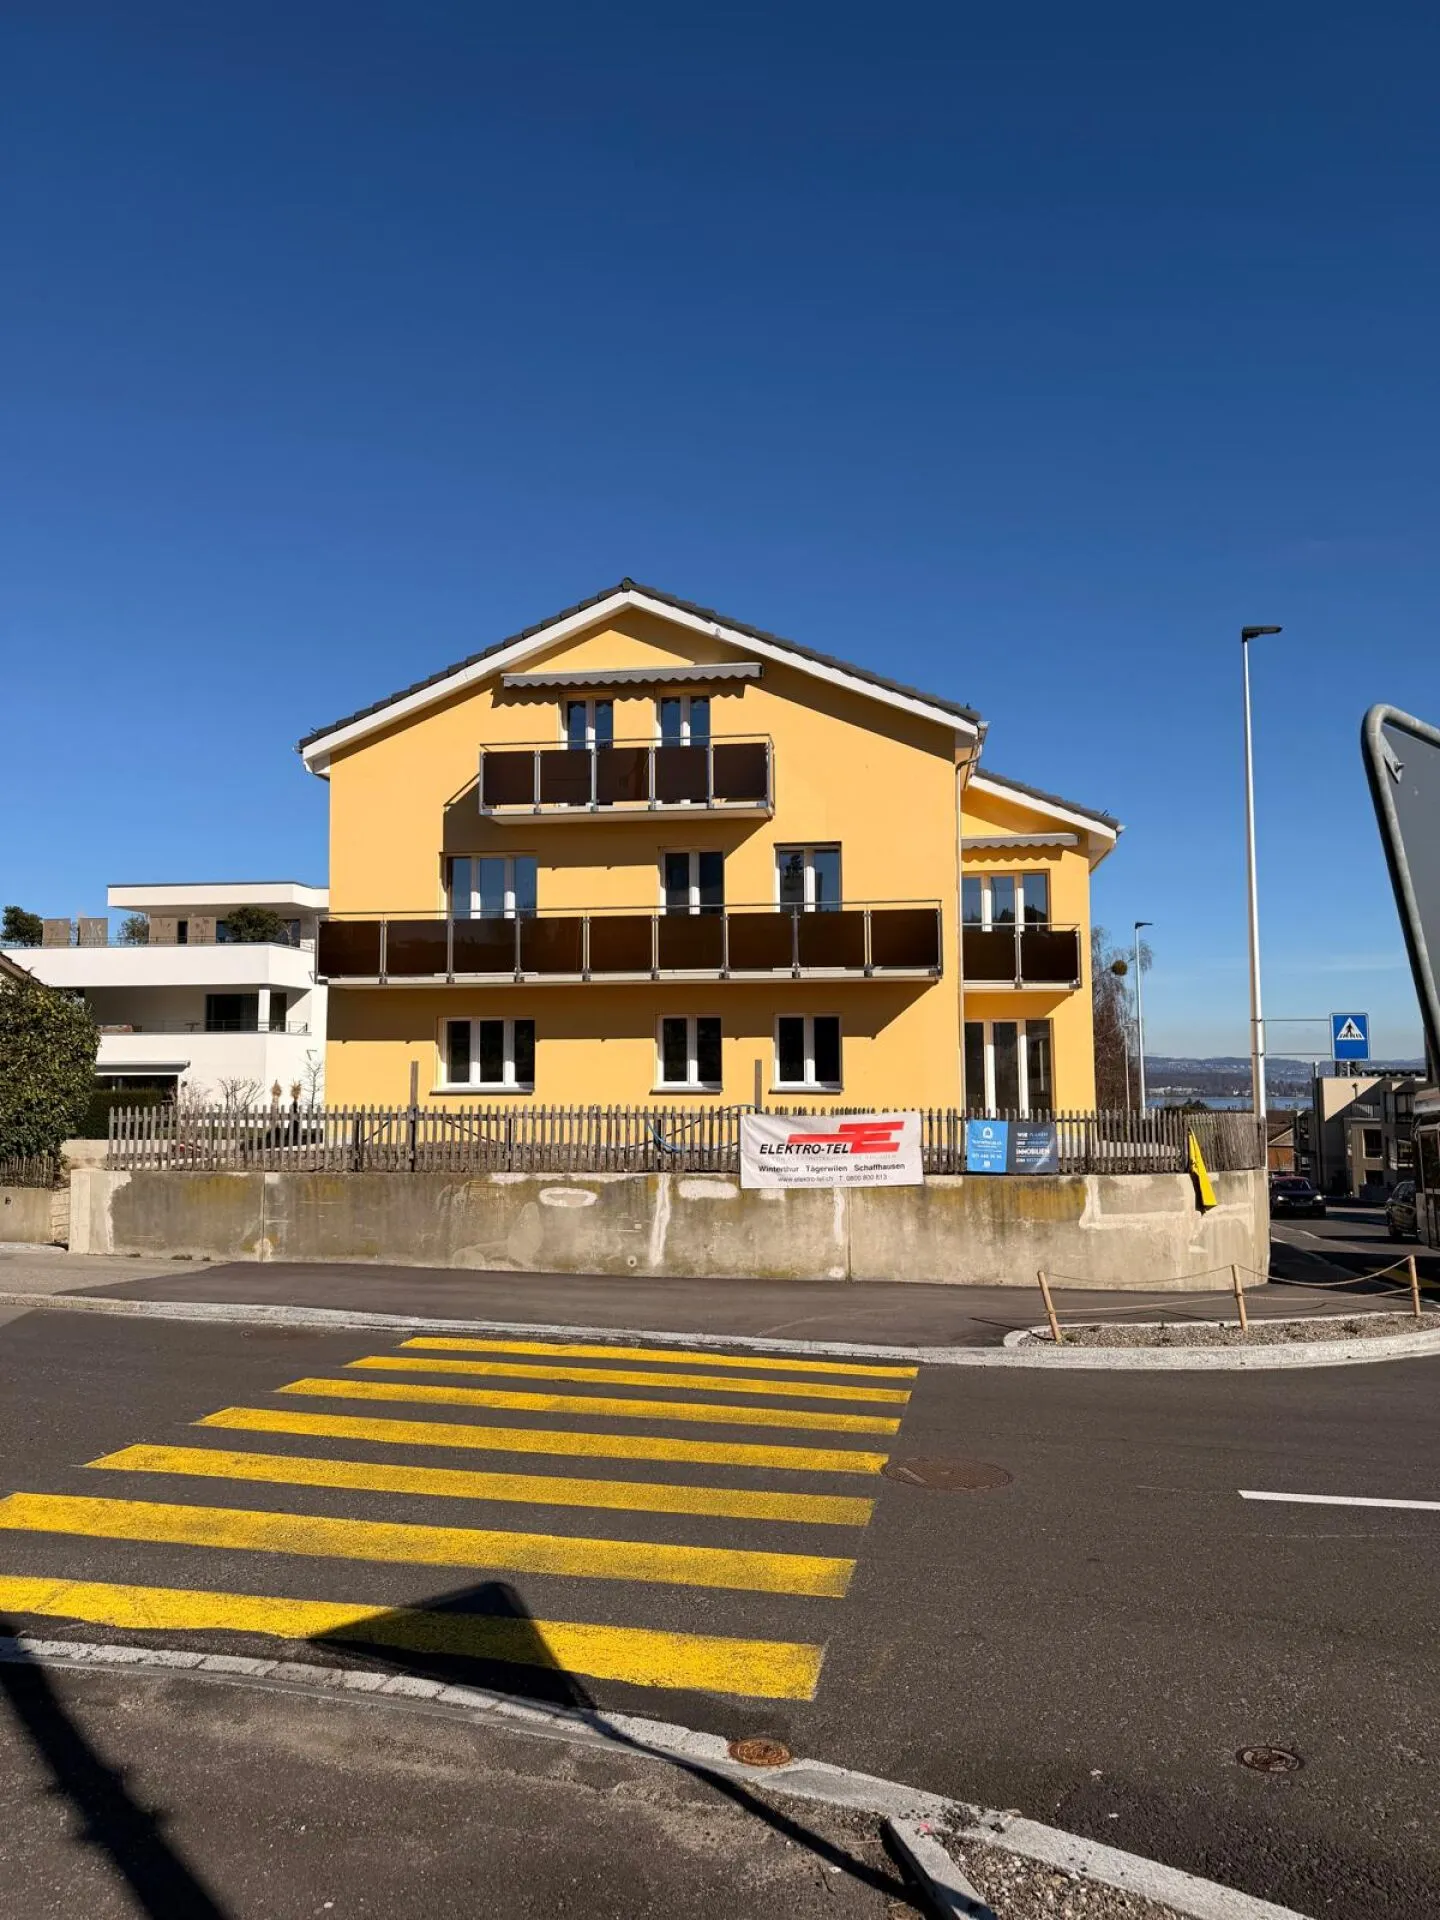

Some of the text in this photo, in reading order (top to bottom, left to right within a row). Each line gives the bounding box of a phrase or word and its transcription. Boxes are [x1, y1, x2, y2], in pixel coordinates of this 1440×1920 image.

[759, 1143, 849, 1155] ELEKTRO-TEL
[758, 1165, 799, 1173] Winterthur
[854, 1163, 906, 1172] Schaffhausen
